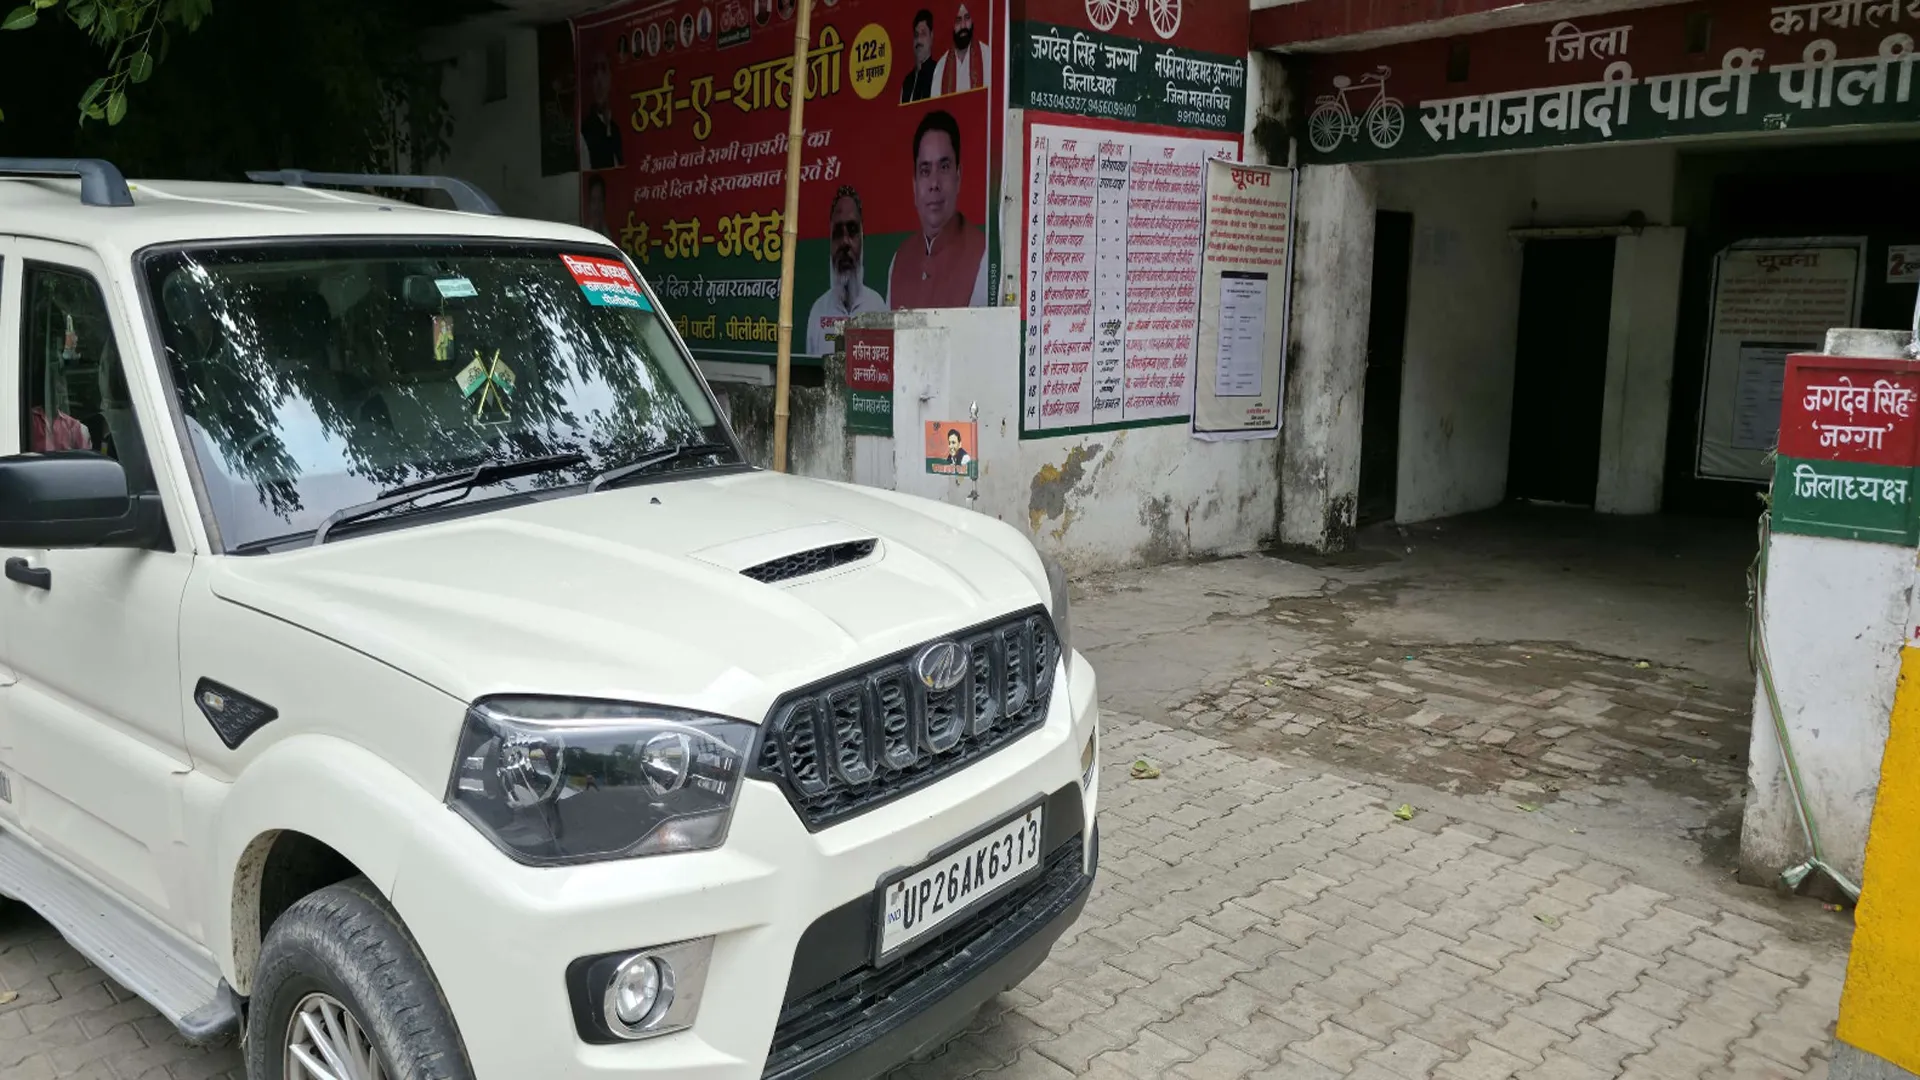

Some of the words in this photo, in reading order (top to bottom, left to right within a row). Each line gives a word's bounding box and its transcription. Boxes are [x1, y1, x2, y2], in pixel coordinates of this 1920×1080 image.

[855, 40, 877, 63] 122
[1031, 27, 1071, 66] जगदेव
[1073, 32, 1097, 69] सिंह
[1546, 21, 1633, 64] जिला
[1062, 65, 1117, 96] जिलाध्यक्ष
[1186, 60, 1212, 87] अहमद
[1419, 61, 1639, 143] समाजवादी
[1645, 47, 1765, 120] पार्टी
[1769, 33, 1920, 110] पीली
[1166, 81, 1188, 105] जिला
[1189, 86, 1232, 111] महासचिव
[650, 150, 676, 174] आने
[679, 146, 706, 168] वाले
[707, 140, 739, 164] सभी
[807, 129, 833, 148] का
[633, 186, 651, 203] हम
[651, 181, 669, 200] तहे
[669, 177, 692, 198] दिल
[695, 174, 708, 195] से
[709, 169, 782, 195] इस्तकबाल
[1231, 167, 1271, 190] सूचना
[563, 255, 600, 277] जिला
[1756, 253, 1820, 272] सूचना
[665, 274, 690, 299] दिल
[692, 273, 705, 297] से
[691, 314, 716, 339] पार्टी
[725, 315, 778, 342] पीलीभीत
[1803, 376, 1870, 415] जगदेव
[1873, 379, 1912, 417] सिंह
[1793, 464, 1908, 505] जिलाध्यक्ष
[903, 819, 1038, 929] UP26AK6313
